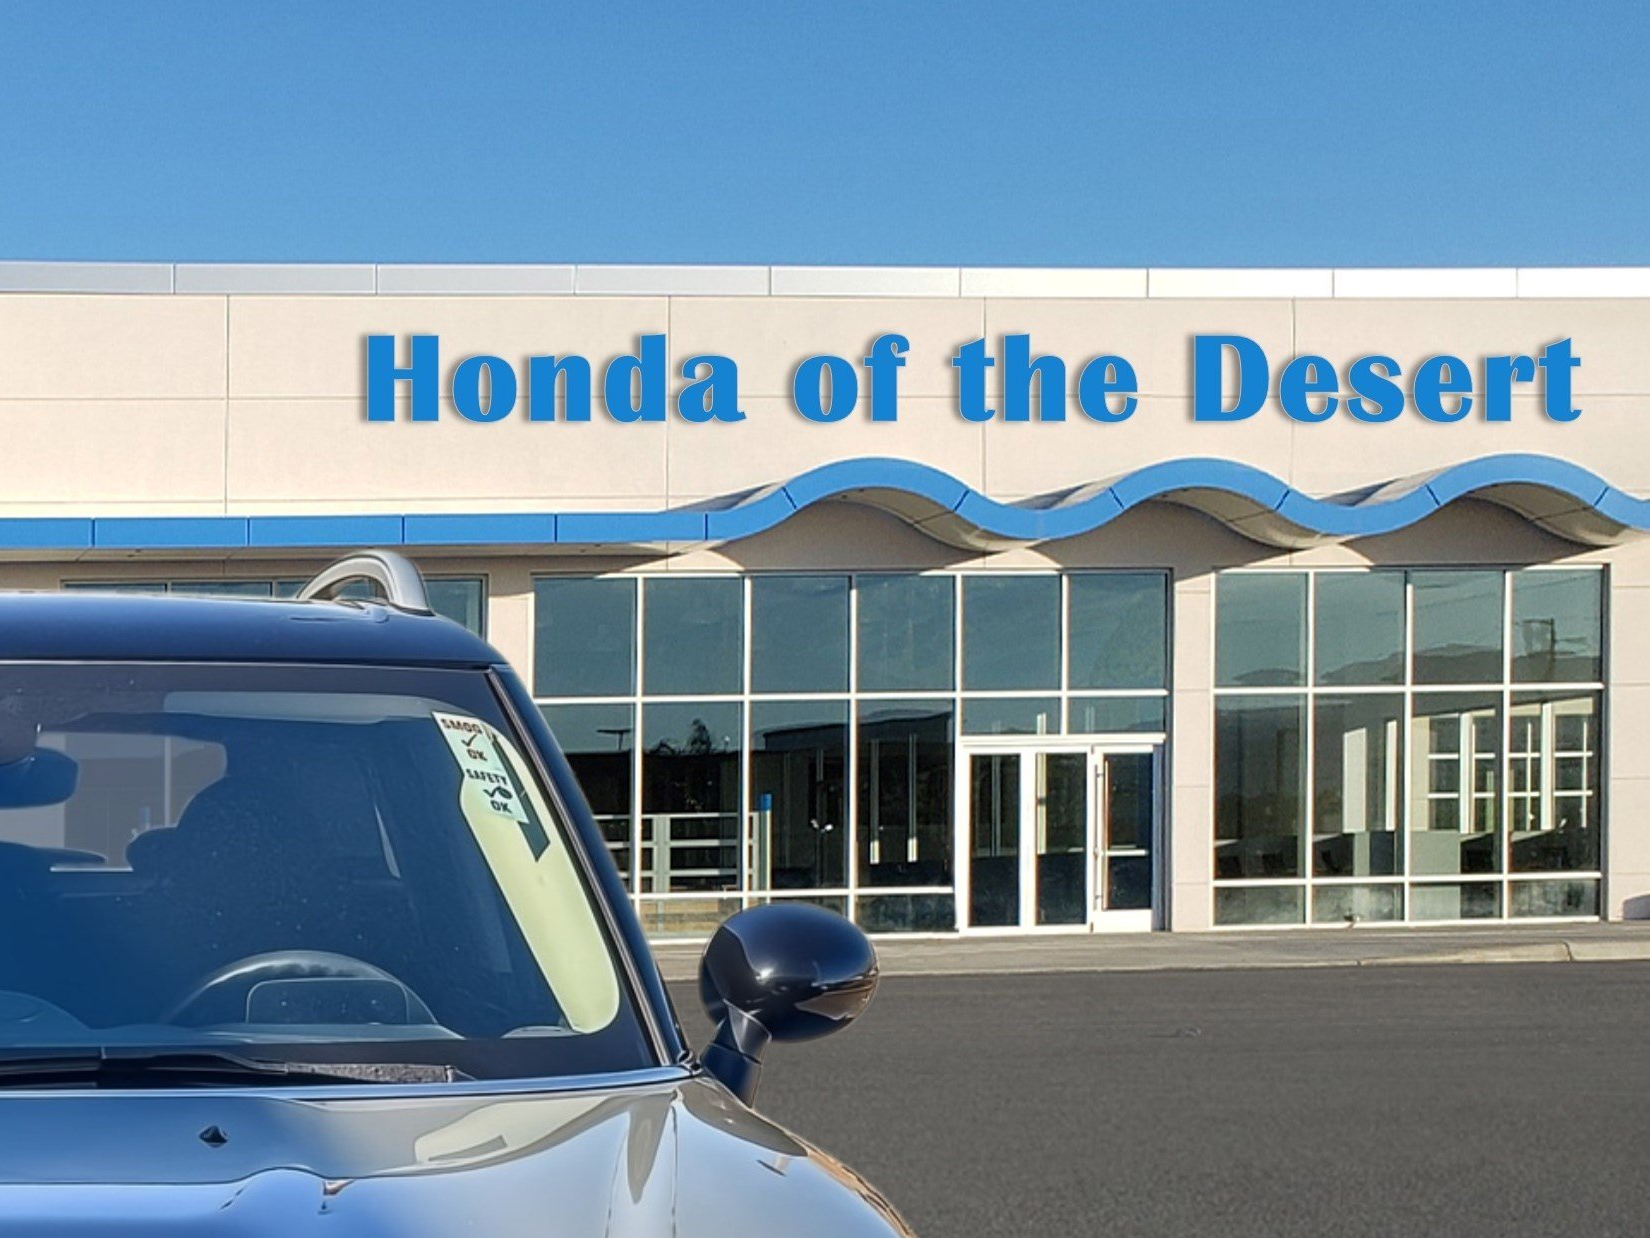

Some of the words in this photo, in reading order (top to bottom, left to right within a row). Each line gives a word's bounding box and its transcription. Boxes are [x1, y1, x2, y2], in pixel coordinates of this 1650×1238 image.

[364, 334, 746, 423] Honda
[793, 333, 910, 423] of
[951, 334, 1138, 423] the
[1192, 335, 1581, 423] Desert
[441, 718, 482, 734] SMOG
[466, 749, 488, 762] OK
[466, 769, 508, 786] SAFETY
[490, 800, 513, 814] OK
